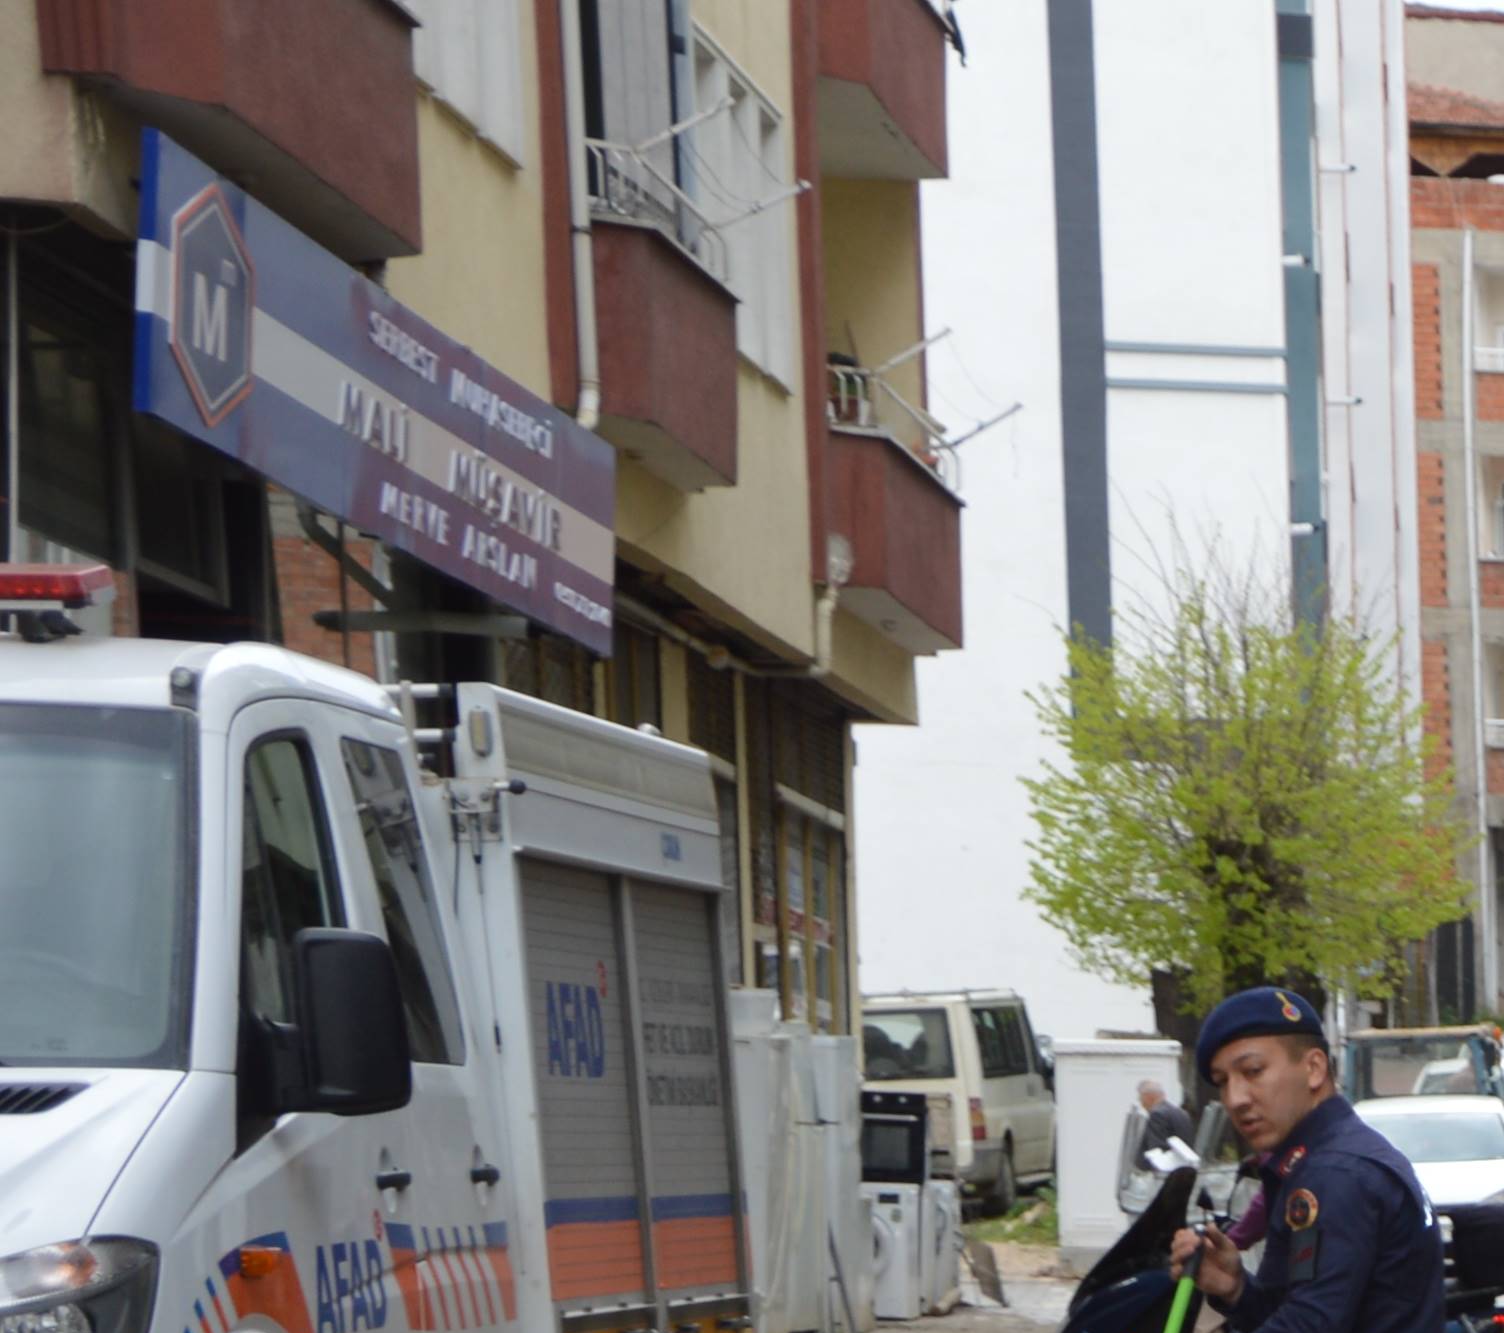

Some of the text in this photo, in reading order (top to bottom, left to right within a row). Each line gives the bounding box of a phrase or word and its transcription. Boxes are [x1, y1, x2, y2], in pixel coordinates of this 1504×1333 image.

[193, 270, 228, 362] M
[337, 379, 562, 551] MALİ MÜŞAVİR
[380, 481, 538, 590] MERVE ARSLAN
[545, 981, 605, 1079] AFAD
